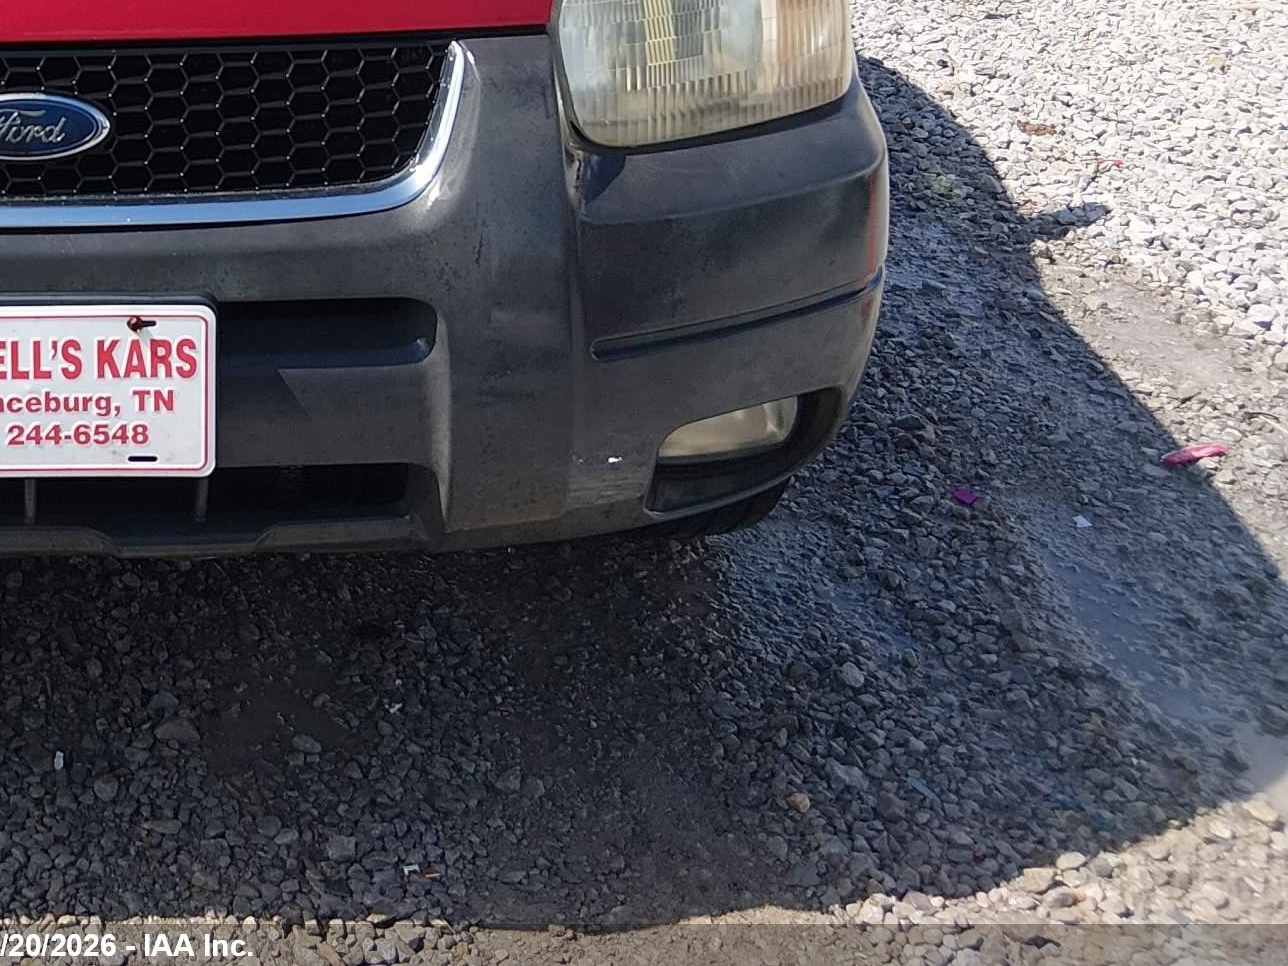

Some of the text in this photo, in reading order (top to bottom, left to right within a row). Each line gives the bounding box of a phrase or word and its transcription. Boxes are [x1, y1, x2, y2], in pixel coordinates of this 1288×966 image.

[97, 338, 197, 379] KARS
[134, 389, 174, 411] TN
[8, 424, 149, 446] 244-6548
